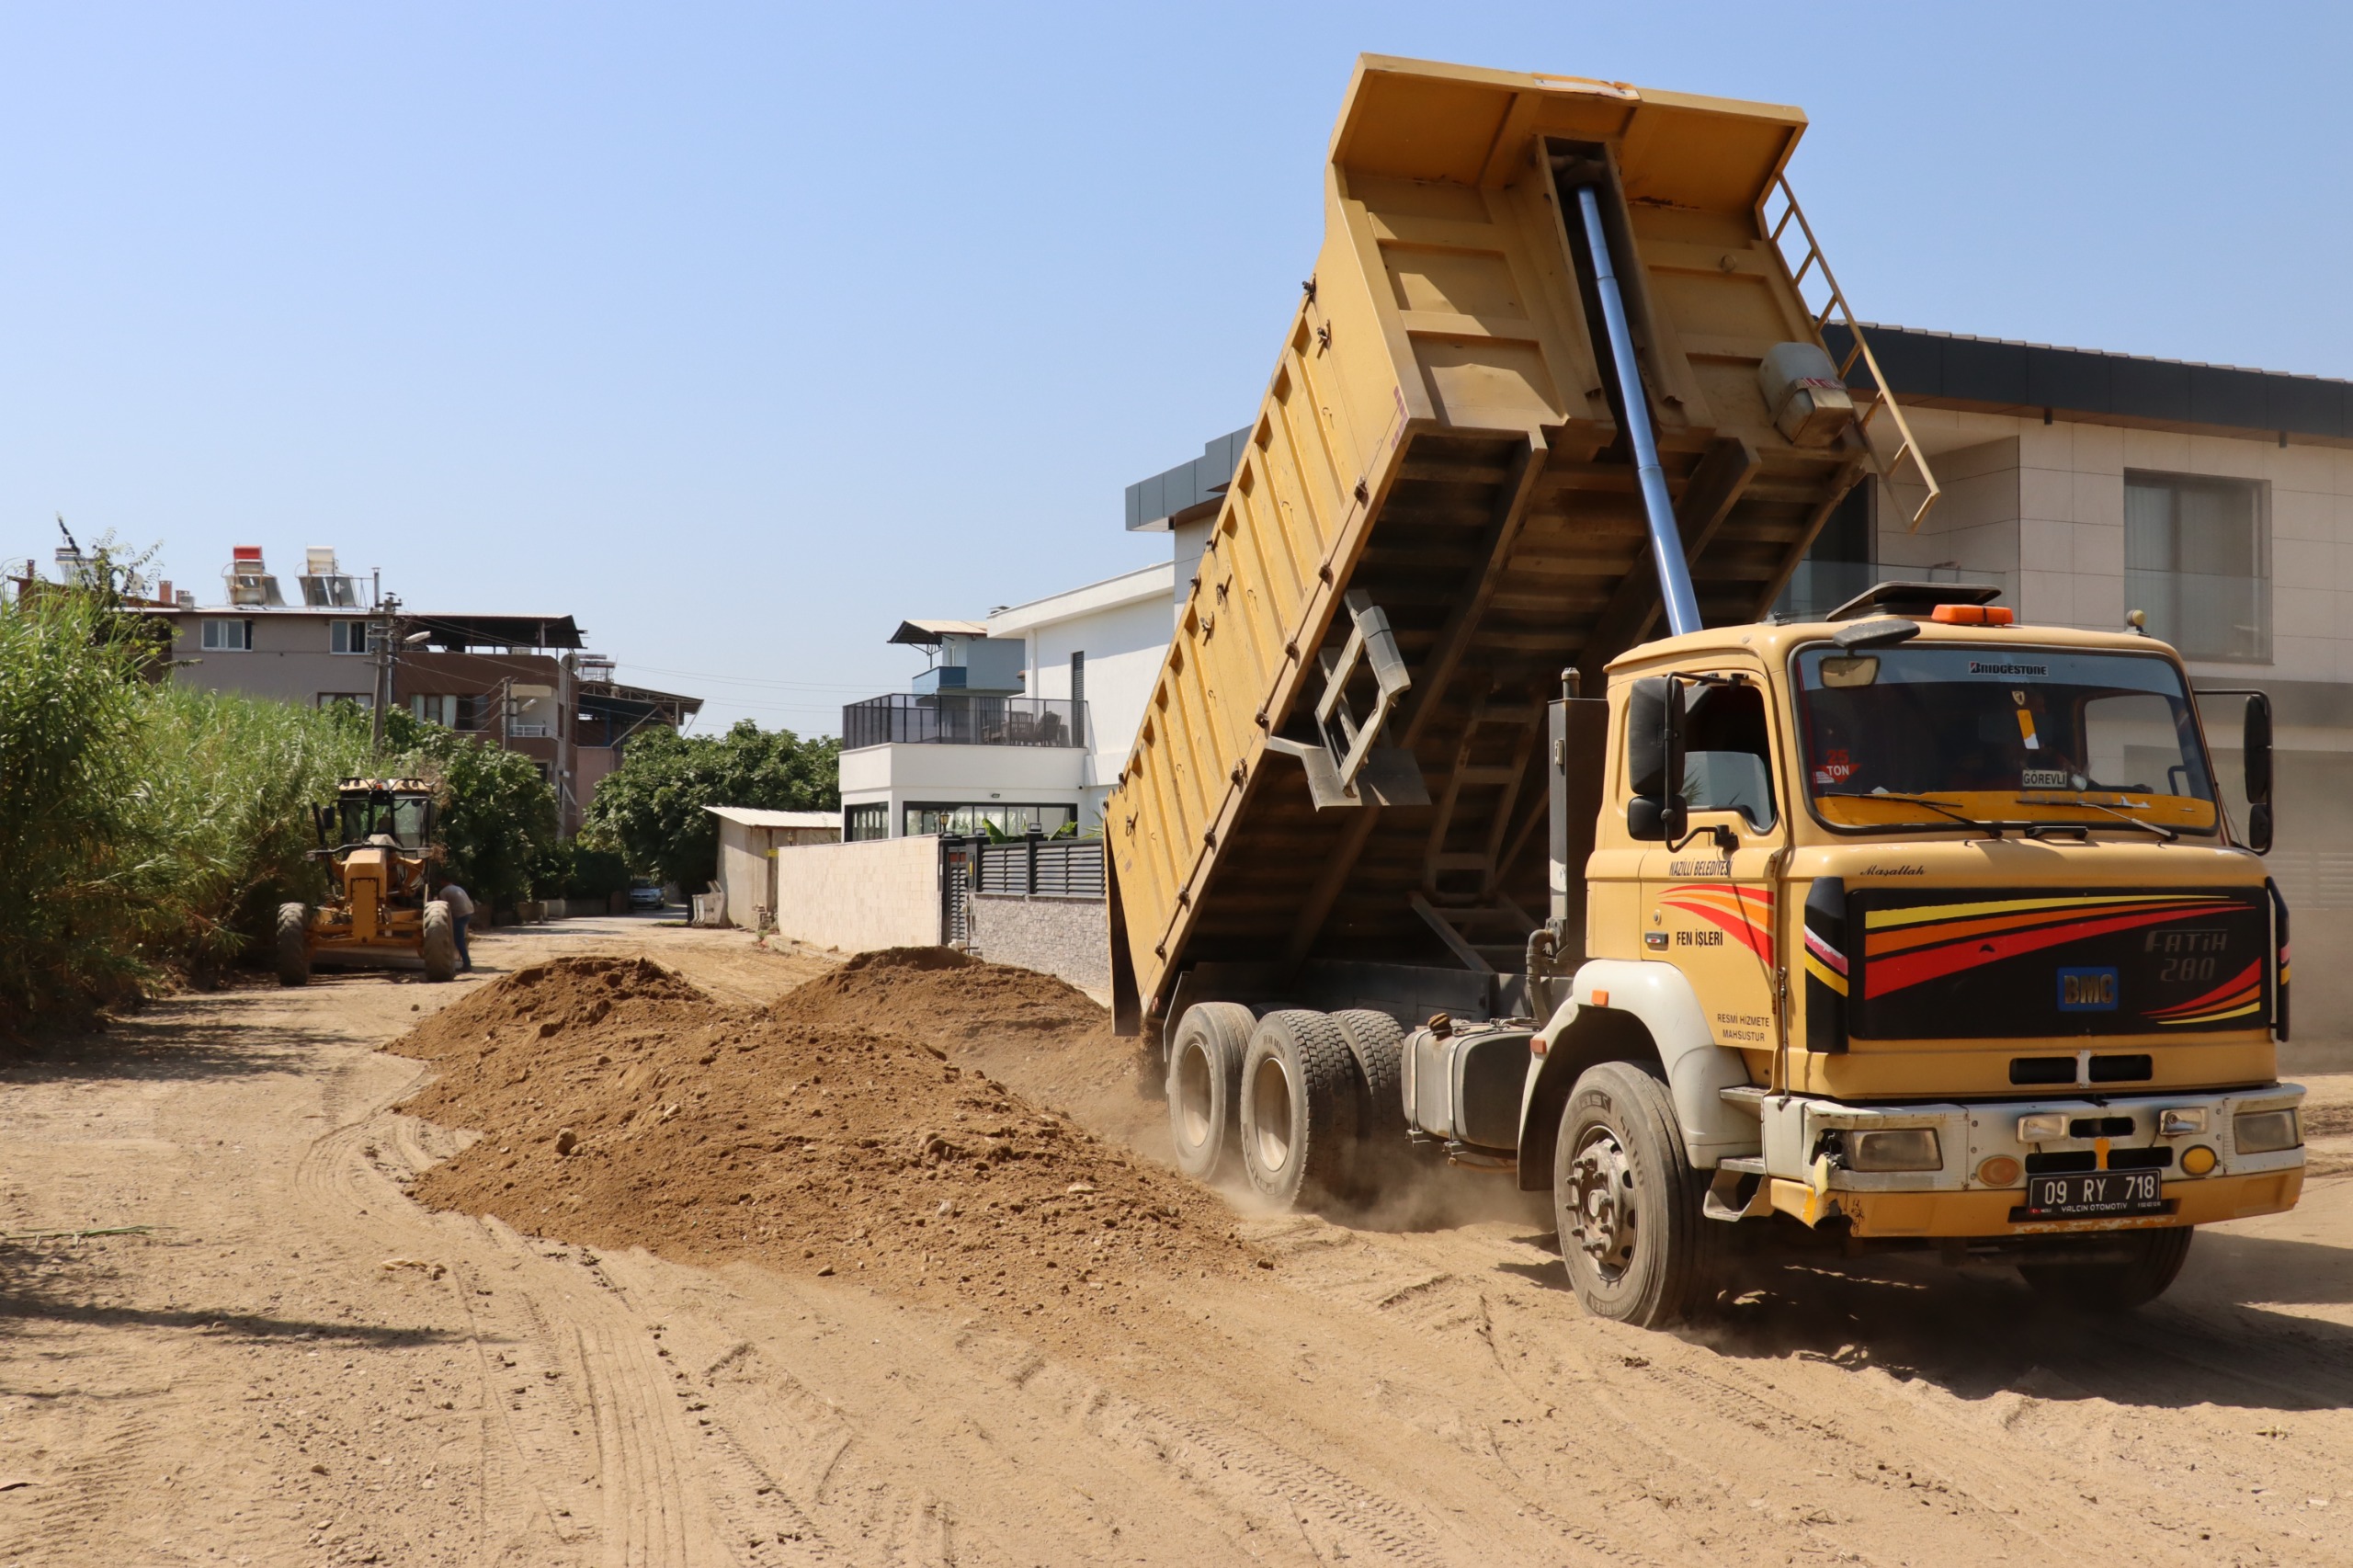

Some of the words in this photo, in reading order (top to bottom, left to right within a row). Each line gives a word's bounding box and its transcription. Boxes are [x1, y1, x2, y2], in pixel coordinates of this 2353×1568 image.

[1970, 662, 2048, 676] BRIDGESTONE
[1825, 749, 1850, 765] 25
[1826, 765, 1850, 777] TON
[1677, 931, 1692, 946] FEN
[1695, 928, 1723, 948] İŞLERİ
[2160, 957, 2215, 982] 280
[2063, 974, 2113, 1004] BMC
[1722, 1029, 1766, 1041] MAHSUSTUR
[2044, 1180, 2067, 1205] 09
[2083, 1178, 2107, 1202] RY
[2125, 1176, 2154, 1199] 718
